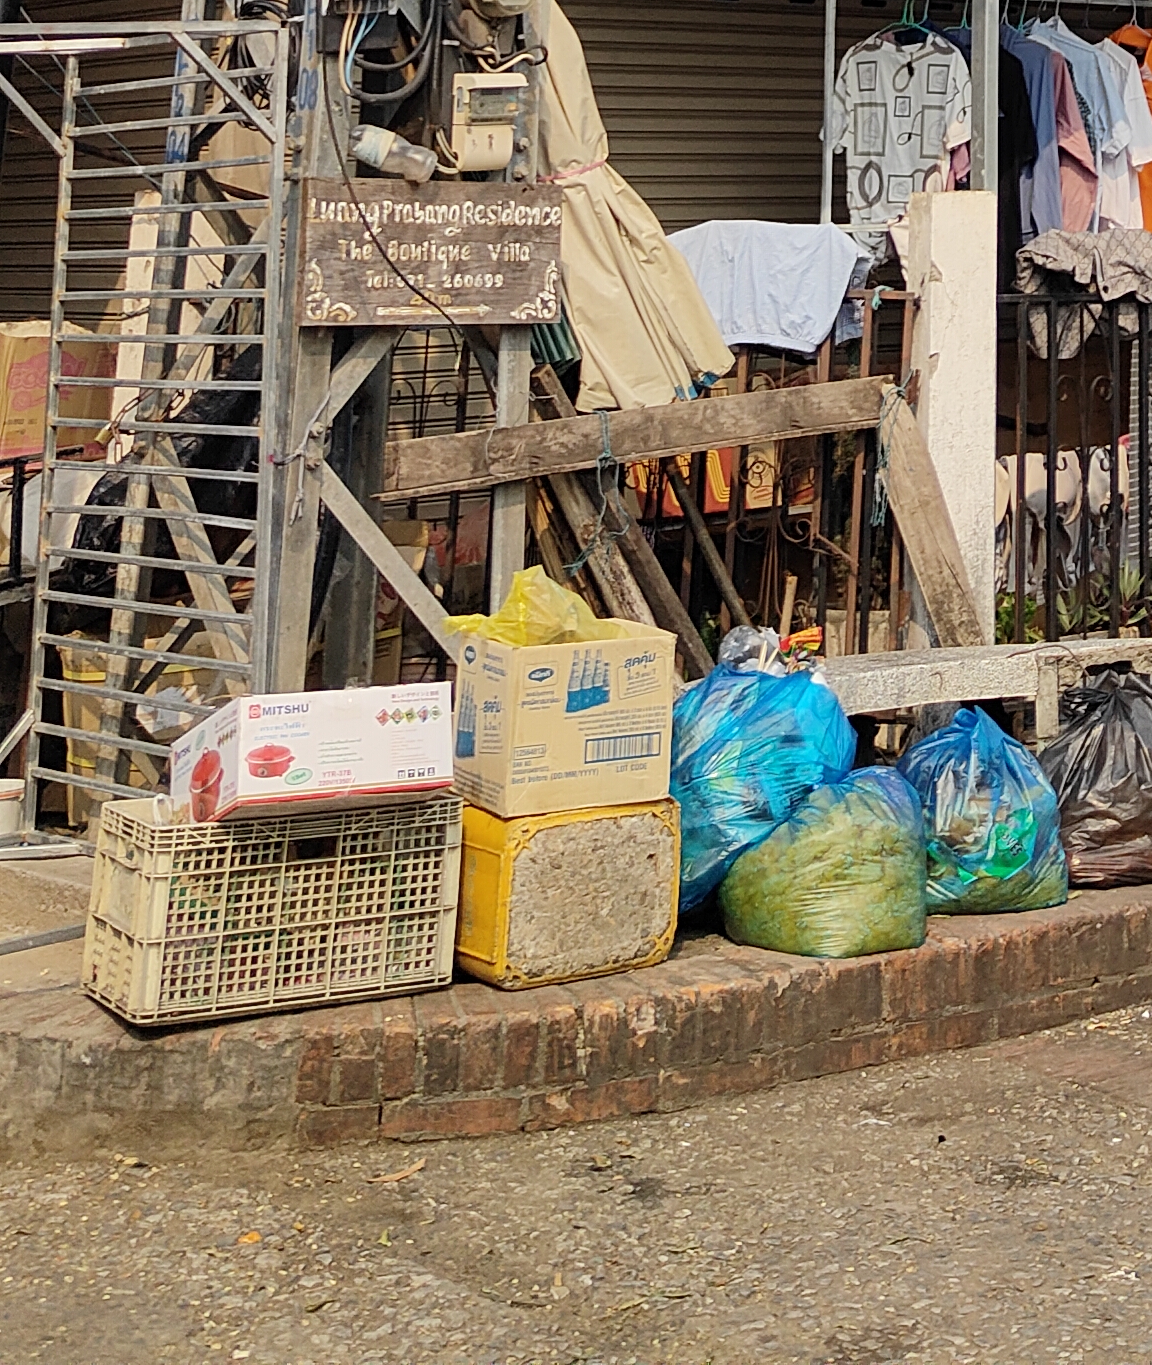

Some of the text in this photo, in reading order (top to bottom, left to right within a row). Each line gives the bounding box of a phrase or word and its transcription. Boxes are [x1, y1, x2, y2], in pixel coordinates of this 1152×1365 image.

[382, 200, 462, 237] Prabang
[462, 200, 562, 226] Residence
[338, 239, 373, 261] The
[387, 240, 471, 269] Boutique
[442, 273, 504, 288] 260699
[262, 703, 309, 716] MITSHU
[616, 762, 648, 773] LOT CODE
[511, 776, 526, 785] Best
